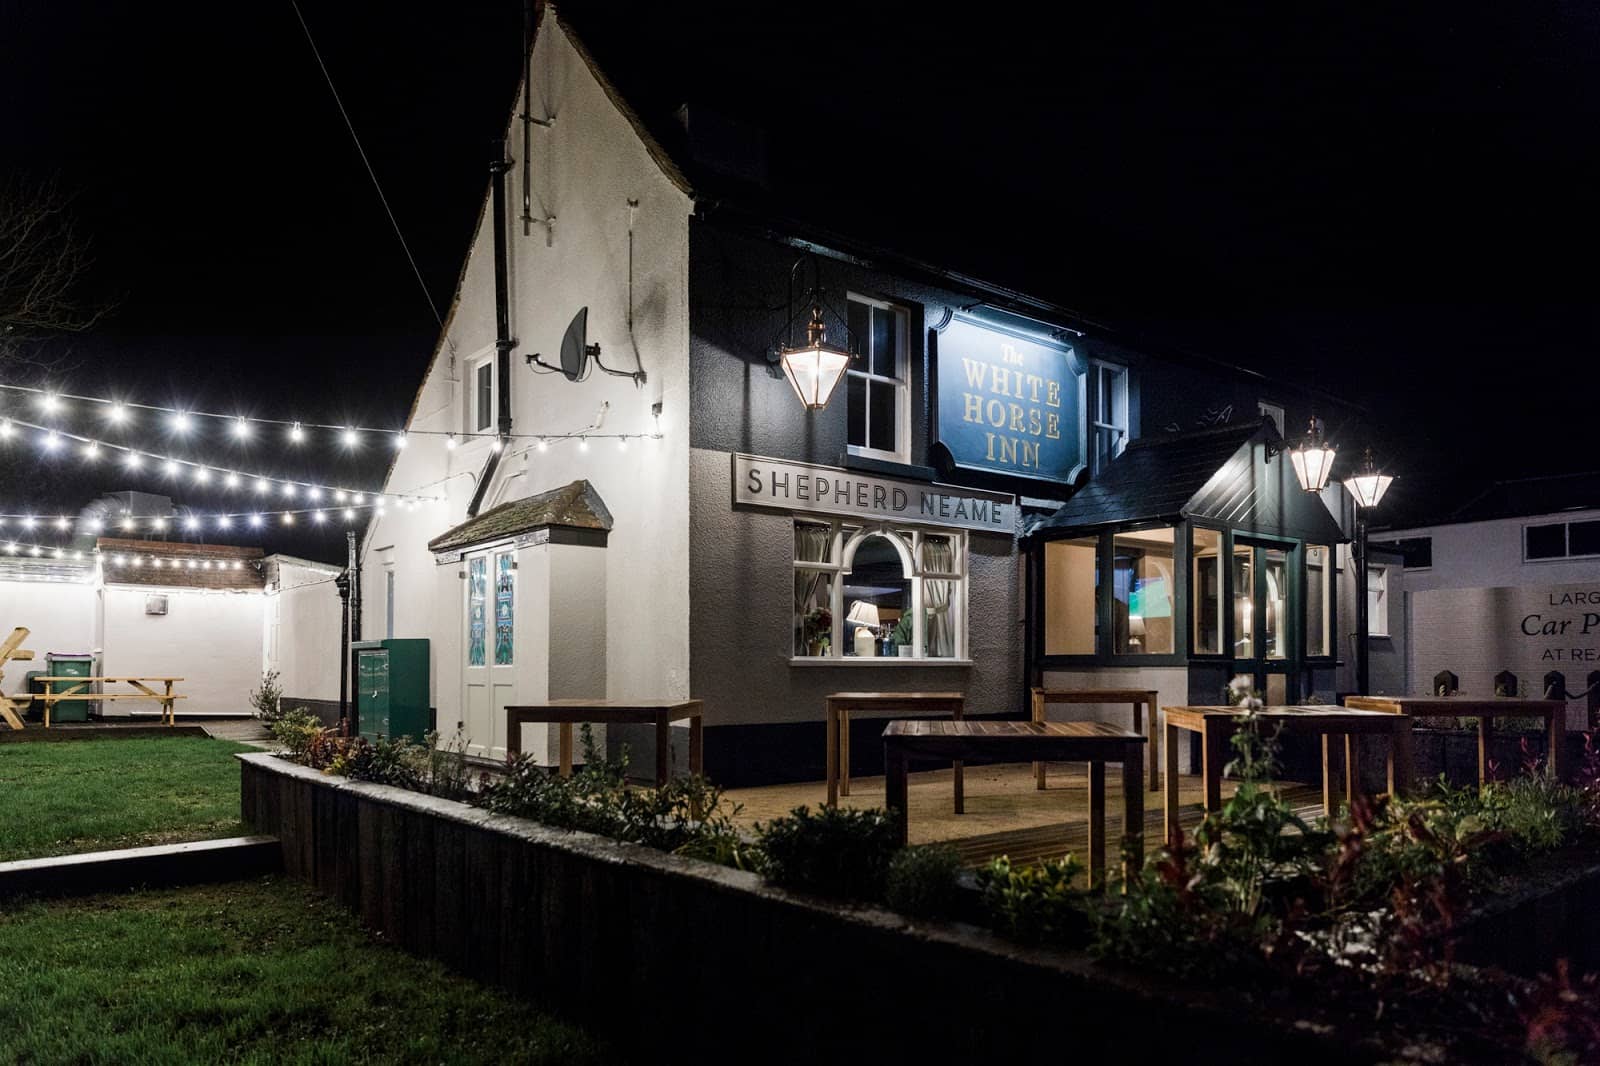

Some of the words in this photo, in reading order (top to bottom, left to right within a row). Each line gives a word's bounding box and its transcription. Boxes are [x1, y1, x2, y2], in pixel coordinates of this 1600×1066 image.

[1001, 343, 1024, 366] The
[962, 357, 1061, 408] WHITE
[962, 392, 1061, 440] HORSE
[985, 432, 1040, 469] INN
[747, 468, 908, 512] SHEPHERD
[920, 490, 1002, 524] NEAME
[1550, 591, 1600, 606] LARG
[1521, 614, 1572, 636] Car
[1542, 648, 1567, 661] AT
[1571, 648, 1600, 661] RE
